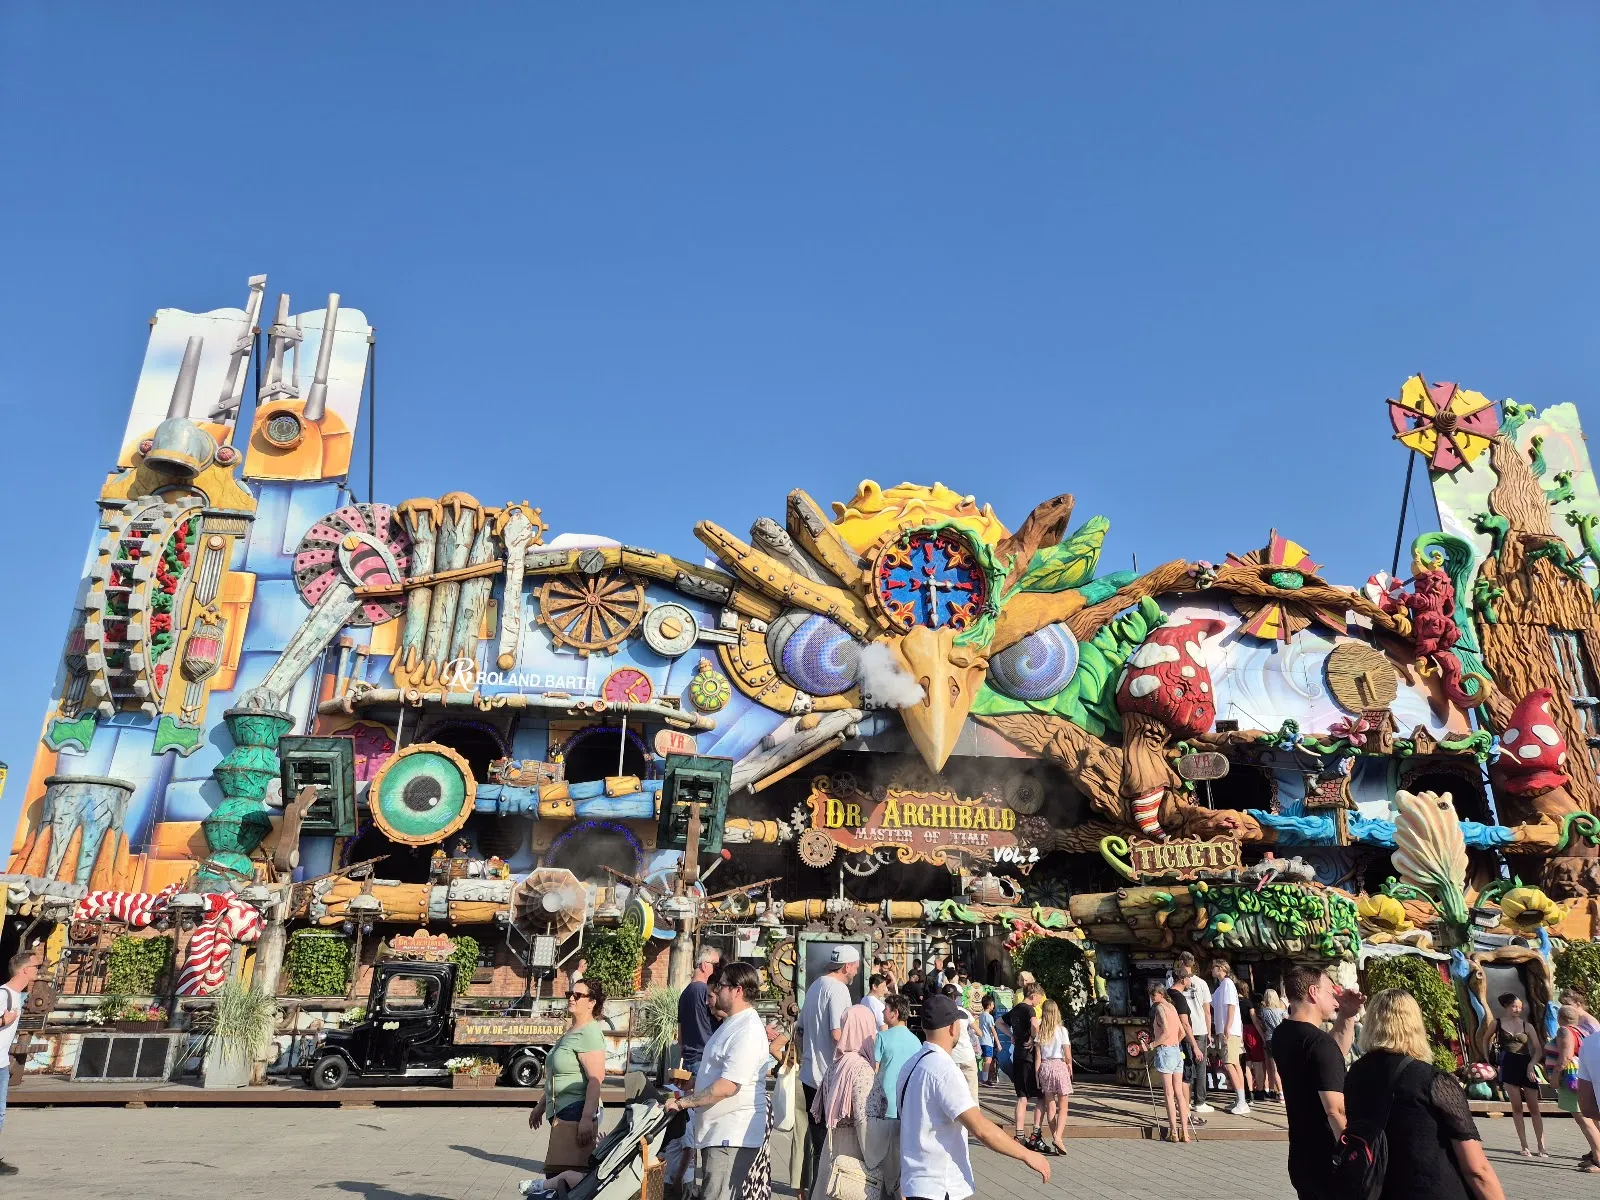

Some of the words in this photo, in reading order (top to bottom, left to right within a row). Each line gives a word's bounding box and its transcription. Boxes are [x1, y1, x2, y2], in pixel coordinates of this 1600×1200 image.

[477, 671, 541, 688] ROLAND
[545, 675, 597, 691] BARTH
[670, 732, 685, 749] VR
[1194, 754, 1212, 768] VR
[825, 798, 868, 830] DR.
[882, 798, 1016, 831] ARCHIBALD
[854, 827, 914, 843] MASTER
[924, 831, 941, 844] OF
[950, 832, 990, 846] TIME
[1136, 841, 1236, 870] TICKETS
